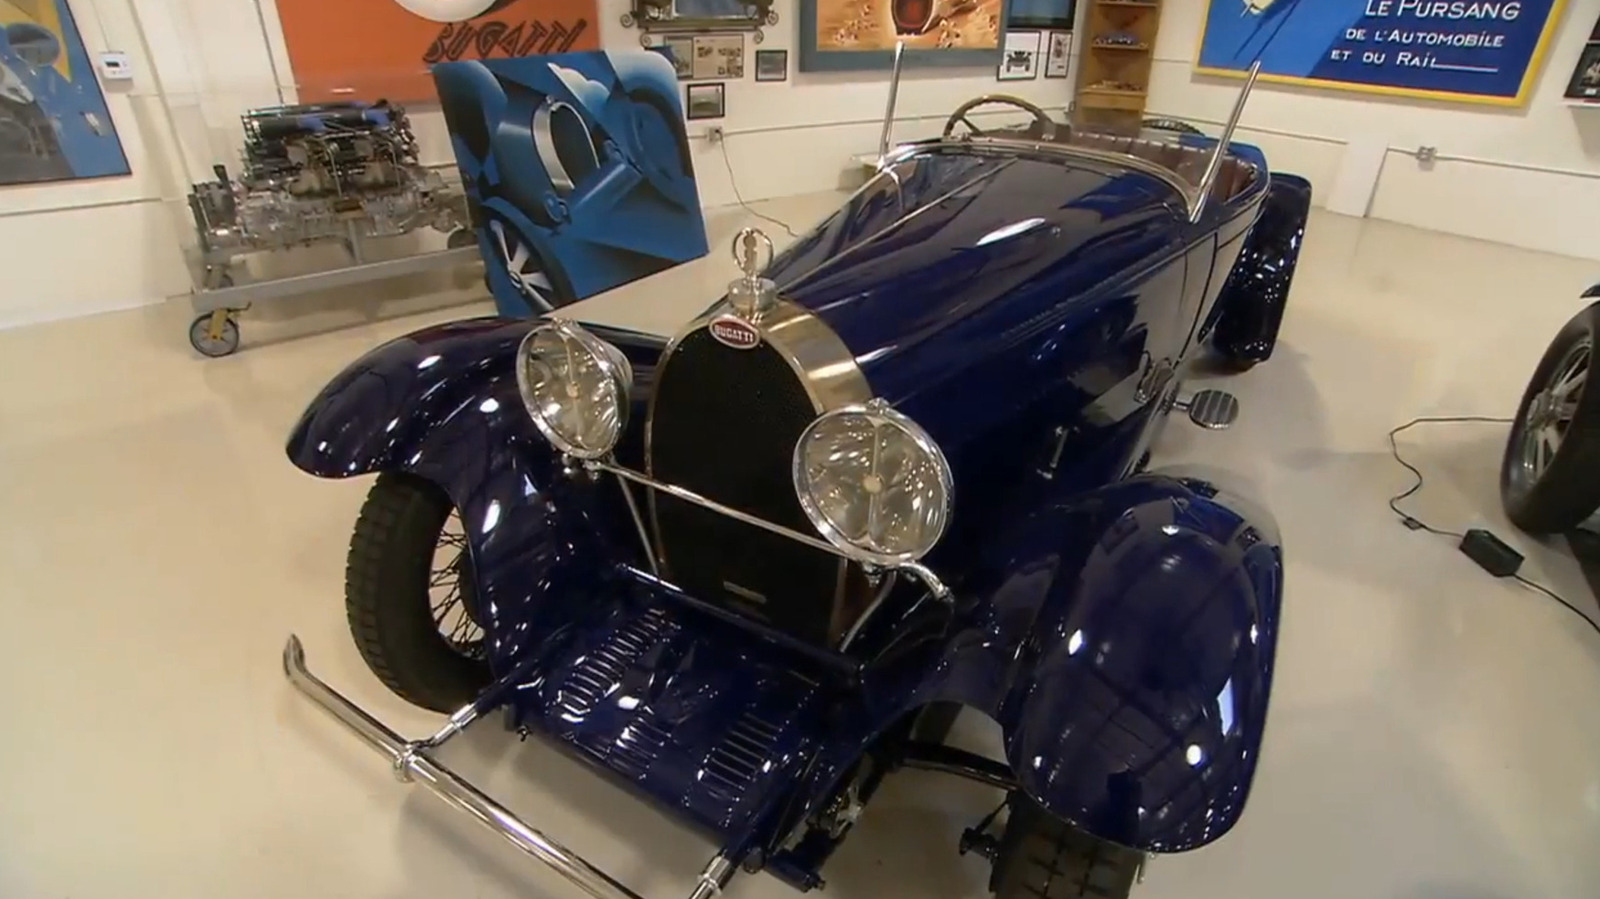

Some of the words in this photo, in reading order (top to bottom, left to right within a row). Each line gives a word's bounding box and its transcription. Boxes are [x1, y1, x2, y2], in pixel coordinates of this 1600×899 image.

[1365, 0, 1392, 16] LE
[1397, 0, 1520, 20] PURSANG
[423, 18, 587, 63] BUGATTI
[1345, 28, 1367, 41] DE
[1330, 49, 1352, 61] ET
[1362, 51, 1386, 64] DU
[714, 324, 754, 343] BUGATTI
